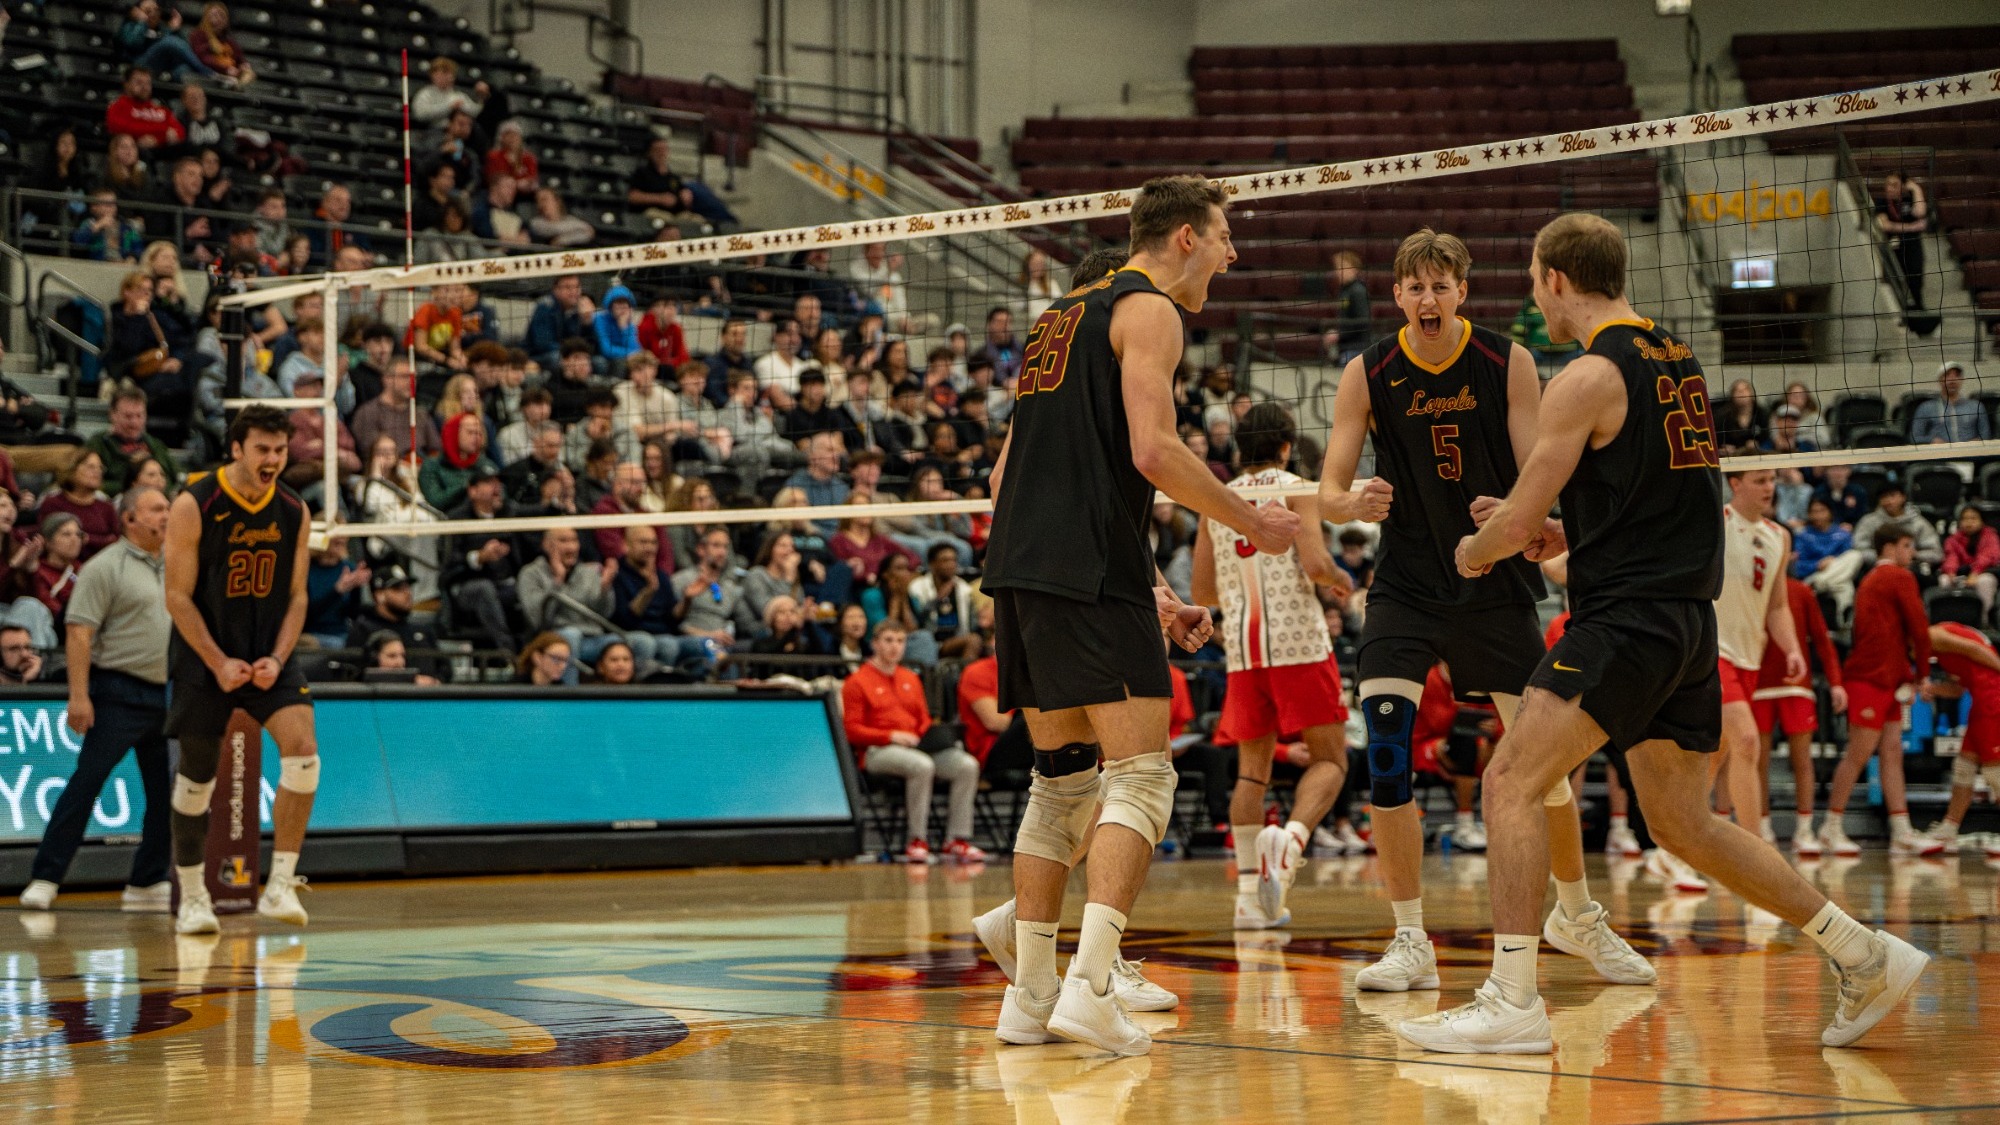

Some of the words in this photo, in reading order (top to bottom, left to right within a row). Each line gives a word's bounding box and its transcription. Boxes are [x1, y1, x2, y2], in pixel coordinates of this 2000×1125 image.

[1016, 301, 1086, 400] 28
[1406, 385, 1477, 419] Loyola
[1656, 375, 1720, 469] 29
[1431, 424, 1462, 481] 5
[226, 549, 277, 599] 20
[1752, 555, 1767, 592] 6
